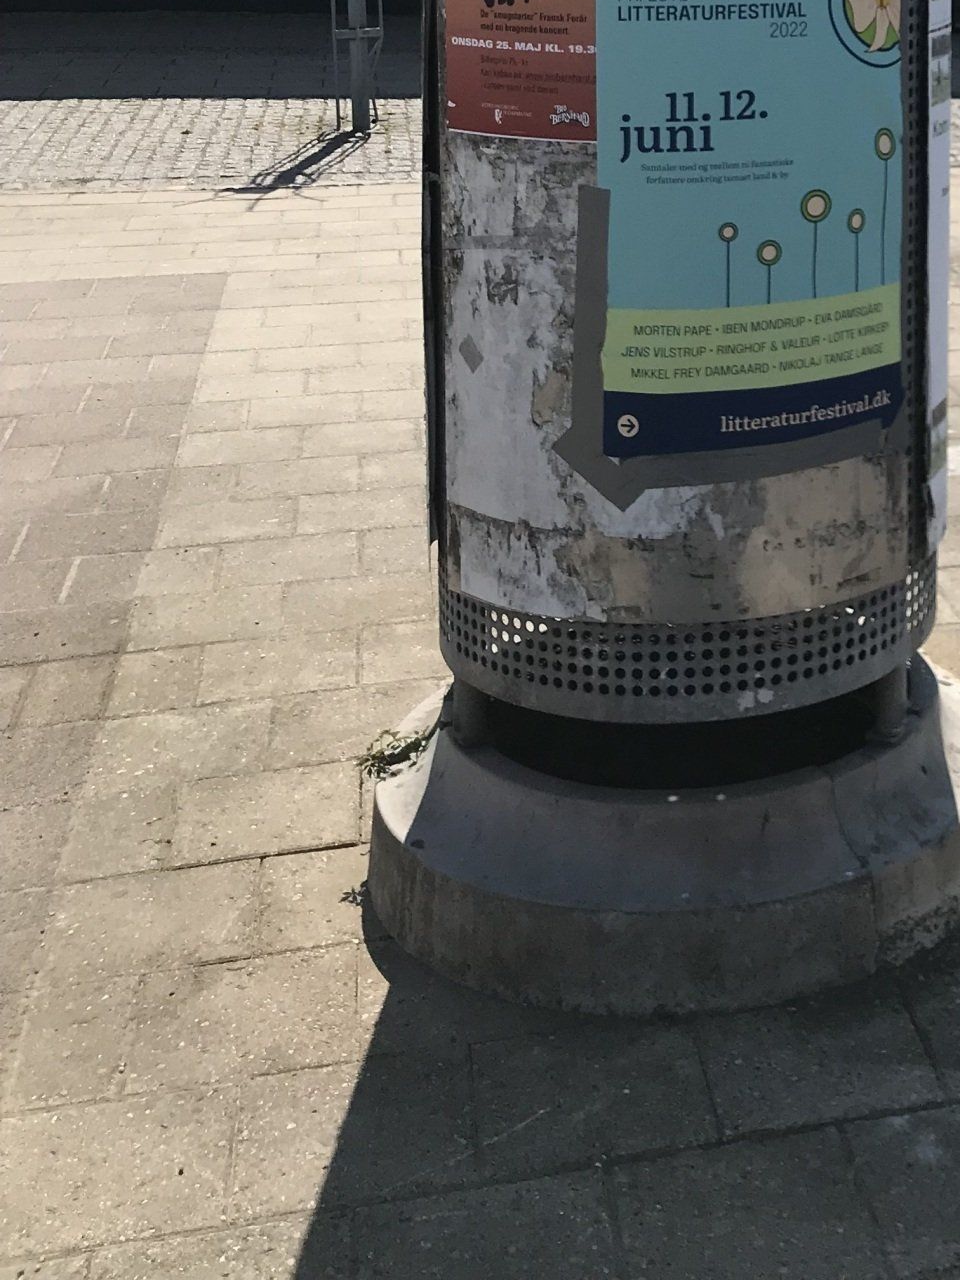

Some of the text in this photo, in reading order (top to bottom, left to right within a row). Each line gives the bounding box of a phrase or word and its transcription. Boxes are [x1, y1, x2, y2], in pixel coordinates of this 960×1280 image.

[618, 2, 807, 22] LITTERATURFESTIVAL
[452, 36, 494, 49] ONSDAG
[496, 41, 512, 50] 25.
[515, 42, 541, 52] MAJ
[545, 43, 564, 53] KL.
[770, 22, 808, 39] 2022
[719, 90, 768, 122] 12.
[620, 114, 715, 163] juni
[633, 324, 681, 337] MORTEN
[684, 324, 712, 336] PAPE
[722, 322, 748, 335] IBEN
[751, 316, 806, 333] MONDRUP
[814, 312, 832, 326] EVA
[621, 346, 650, 358] JENS
[654, 346, 707, 358] VILSTRUP
[717, 343, 768, 356] RINGHOF
[770, 341, 778, 353] &
[781, 335, 820, 351] VALEUR
[828, 328, 856, 344] LOTTE
[631, 342, 884, 380] MIKKEL FREY DAMGAARD NIKOLAJ TANGE LANGE
[720, 390, 892, 433] litteraturfestival.dk
